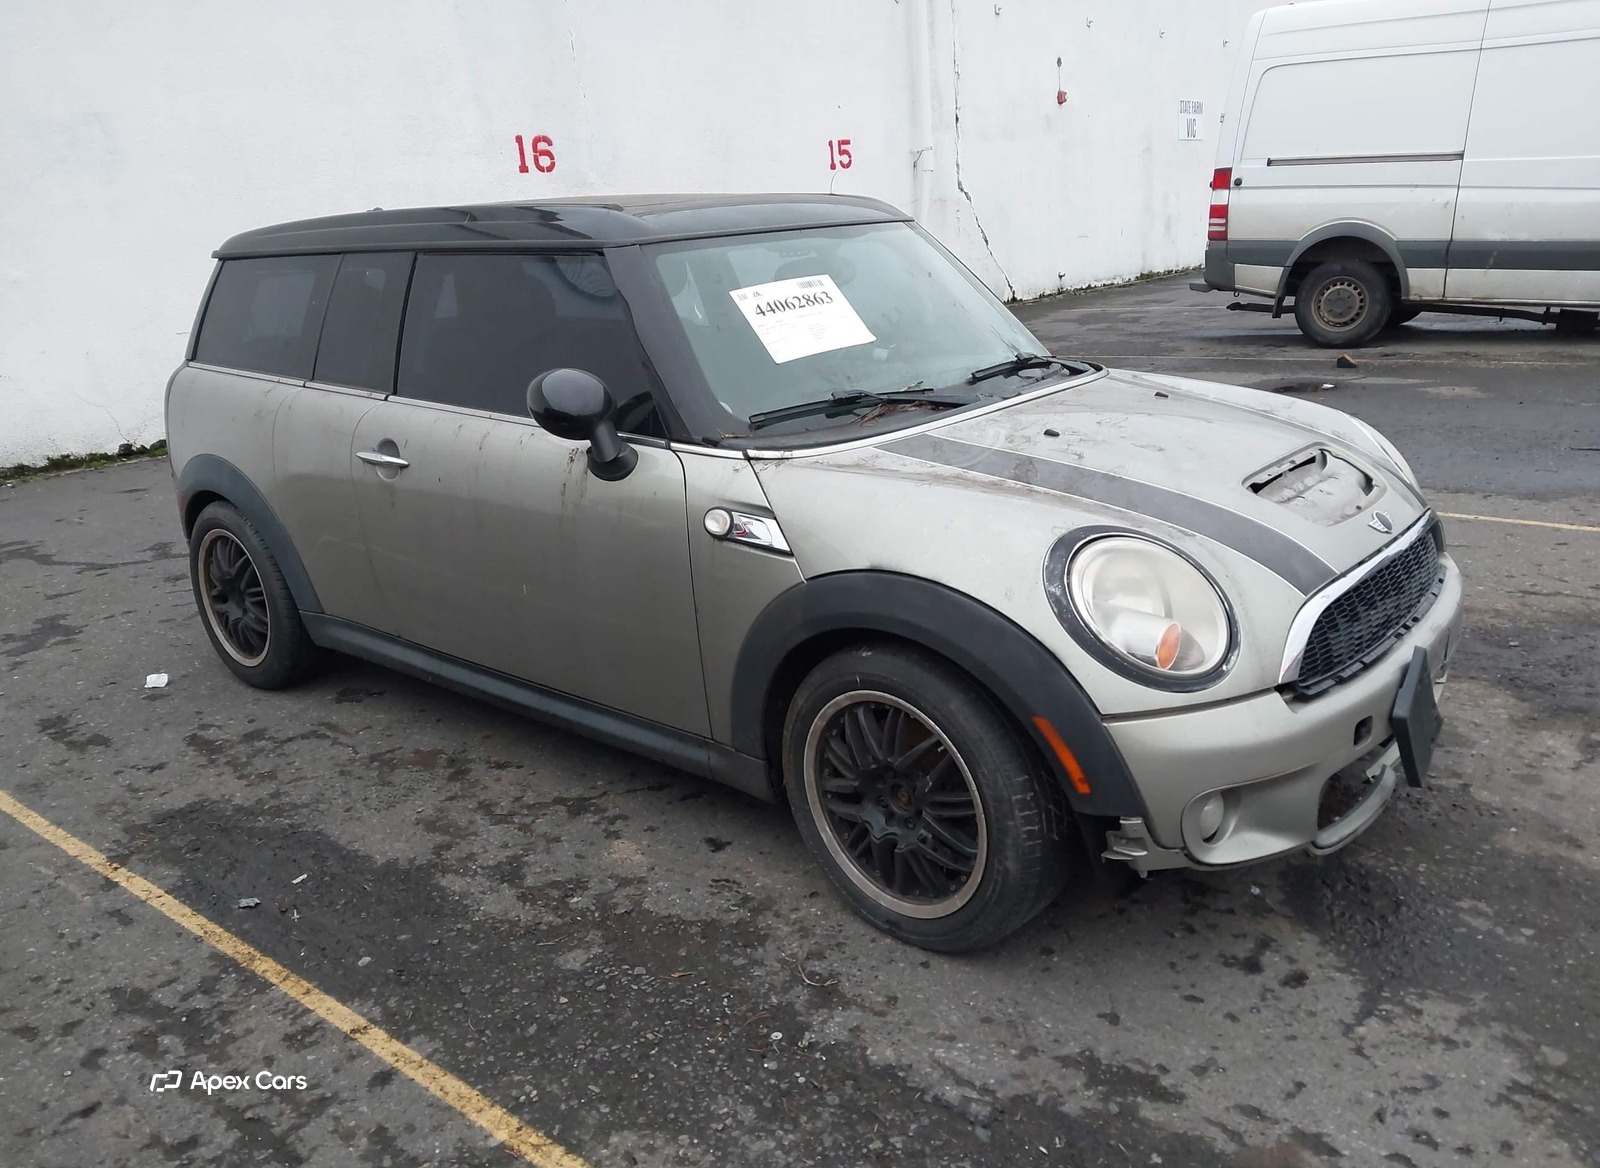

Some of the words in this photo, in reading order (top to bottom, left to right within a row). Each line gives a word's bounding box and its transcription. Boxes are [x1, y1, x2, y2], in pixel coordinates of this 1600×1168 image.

[1186, 118, 1196, 138] VIC
[515, 134, 556, 174] 16
[828, 139, 852, 170] 15
[755, 291, 834, 317] 44062863
